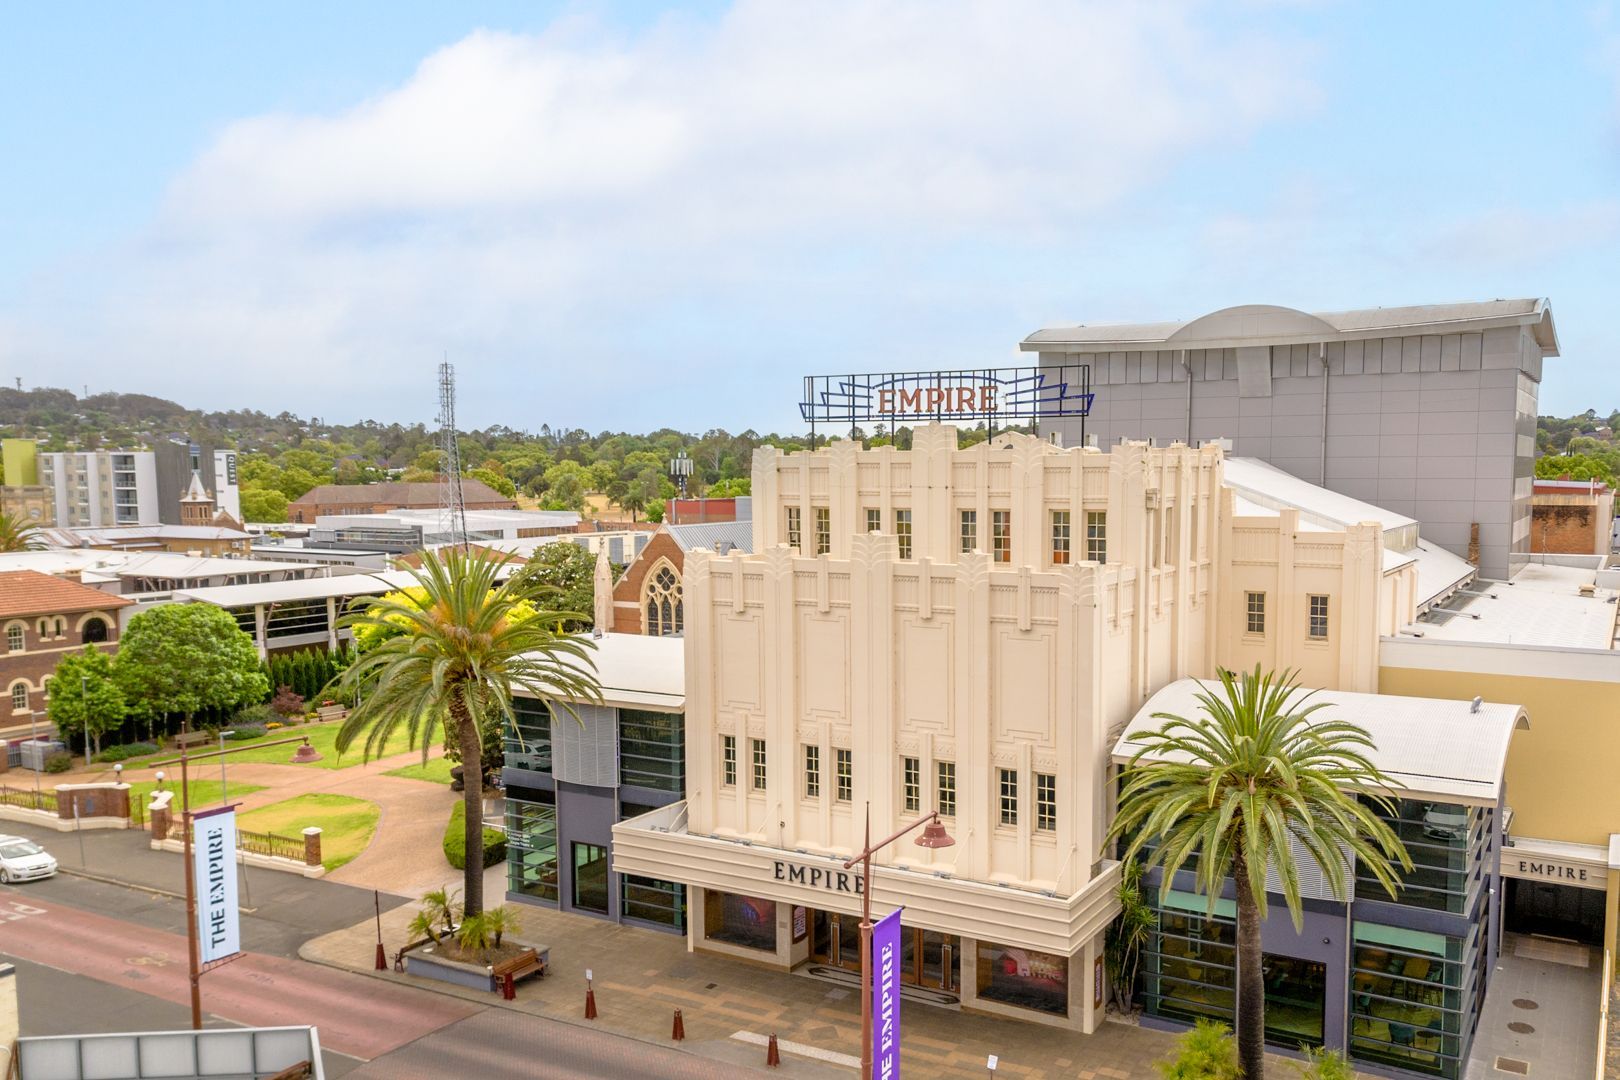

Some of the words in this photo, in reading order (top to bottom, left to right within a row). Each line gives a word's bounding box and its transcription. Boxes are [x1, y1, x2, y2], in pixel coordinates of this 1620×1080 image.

[878, 386, 998, 413] EMPIRE
[228, 456, 236, 483] QUEST
[208, 828, 224, 905] EMPIRE
[774, 861, 864, 894] EMPIRE
[1519, 861, 1587, 880] EMPIRE
[211, 909, 225, 949] THE
[882, 942, 893, 1053] EMPIRE
